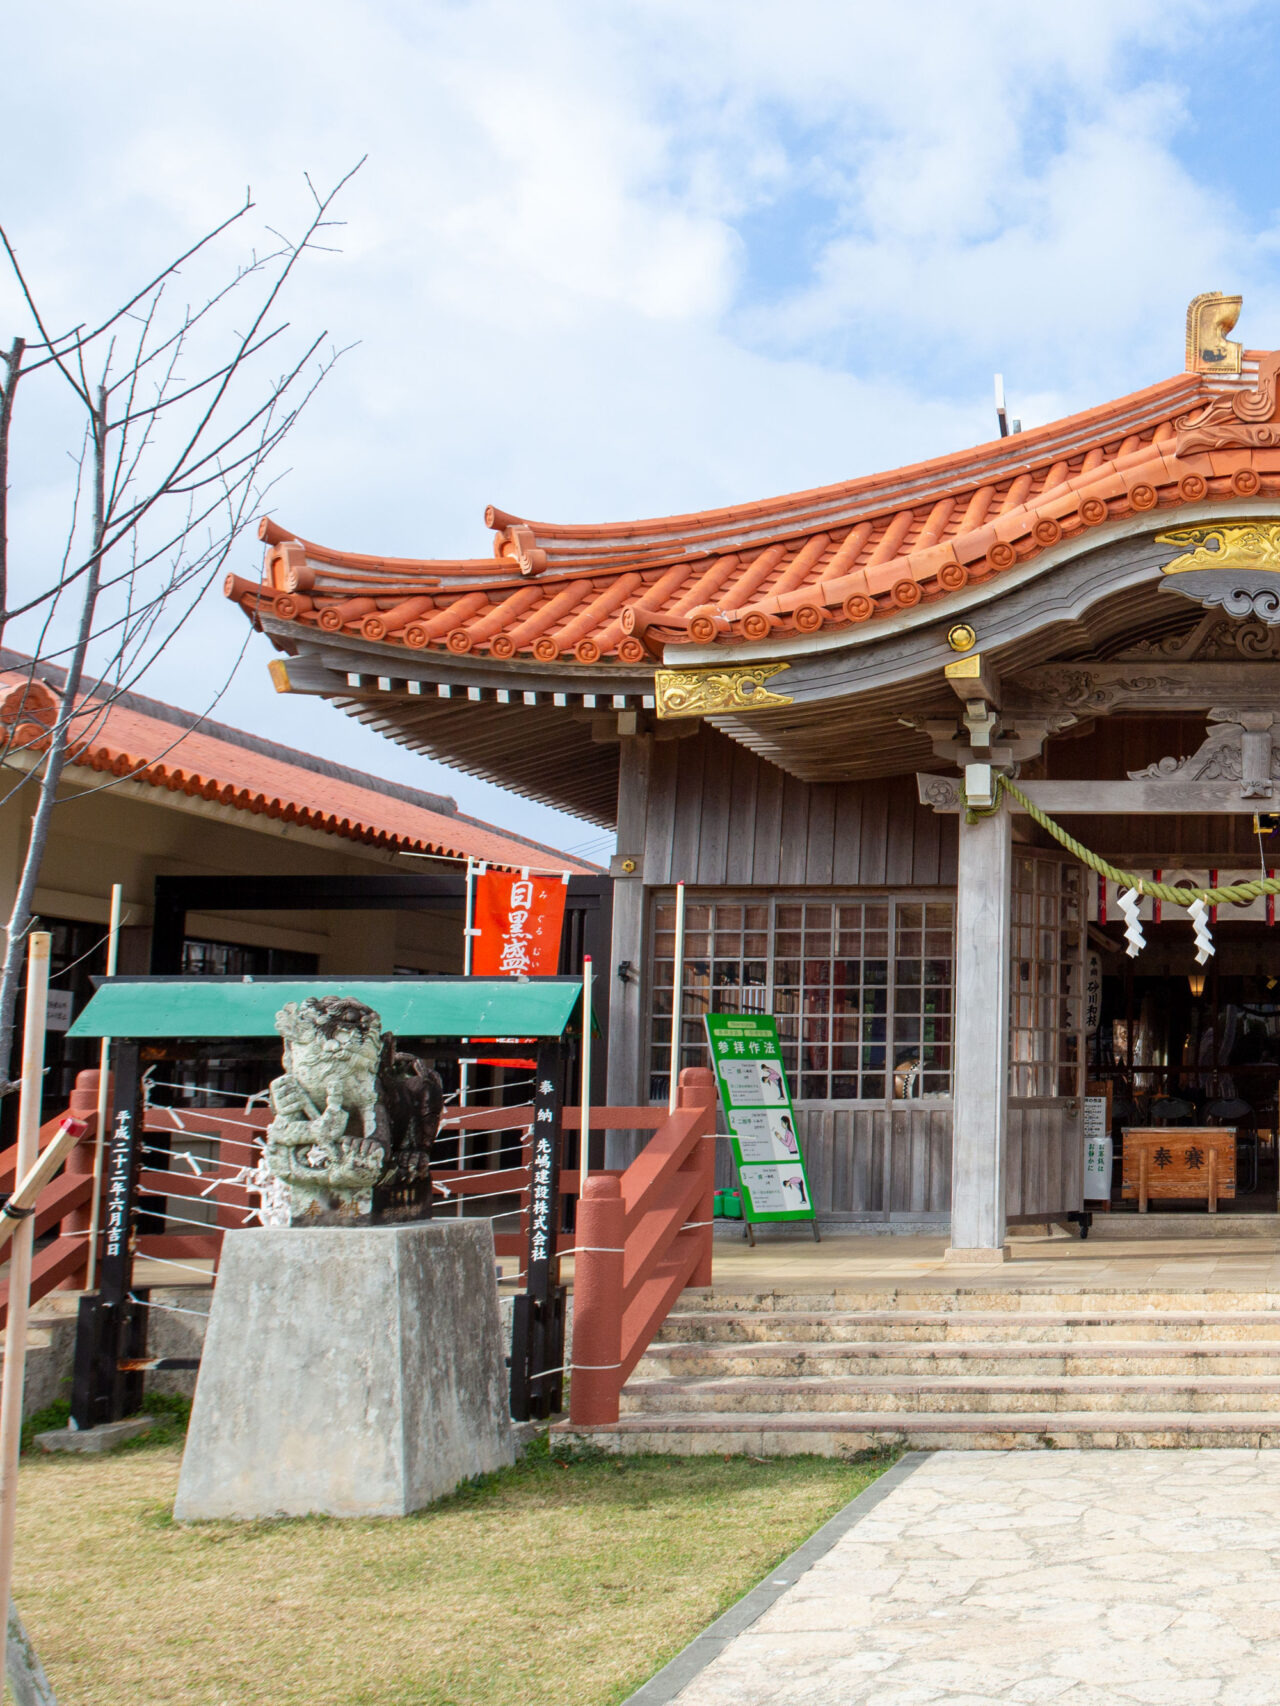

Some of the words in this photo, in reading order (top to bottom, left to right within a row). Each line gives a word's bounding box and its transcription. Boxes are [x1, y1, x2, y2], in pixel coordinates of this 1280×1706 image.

[718, 1041, 775, 1054] 参拝作法
[537, 1080, 555, 1123] 奉納
[107, 1110, 131, 1256] 平成二十二年六月吉日
[531, 1138, 552, 1262] 先嶋建設株式会社
